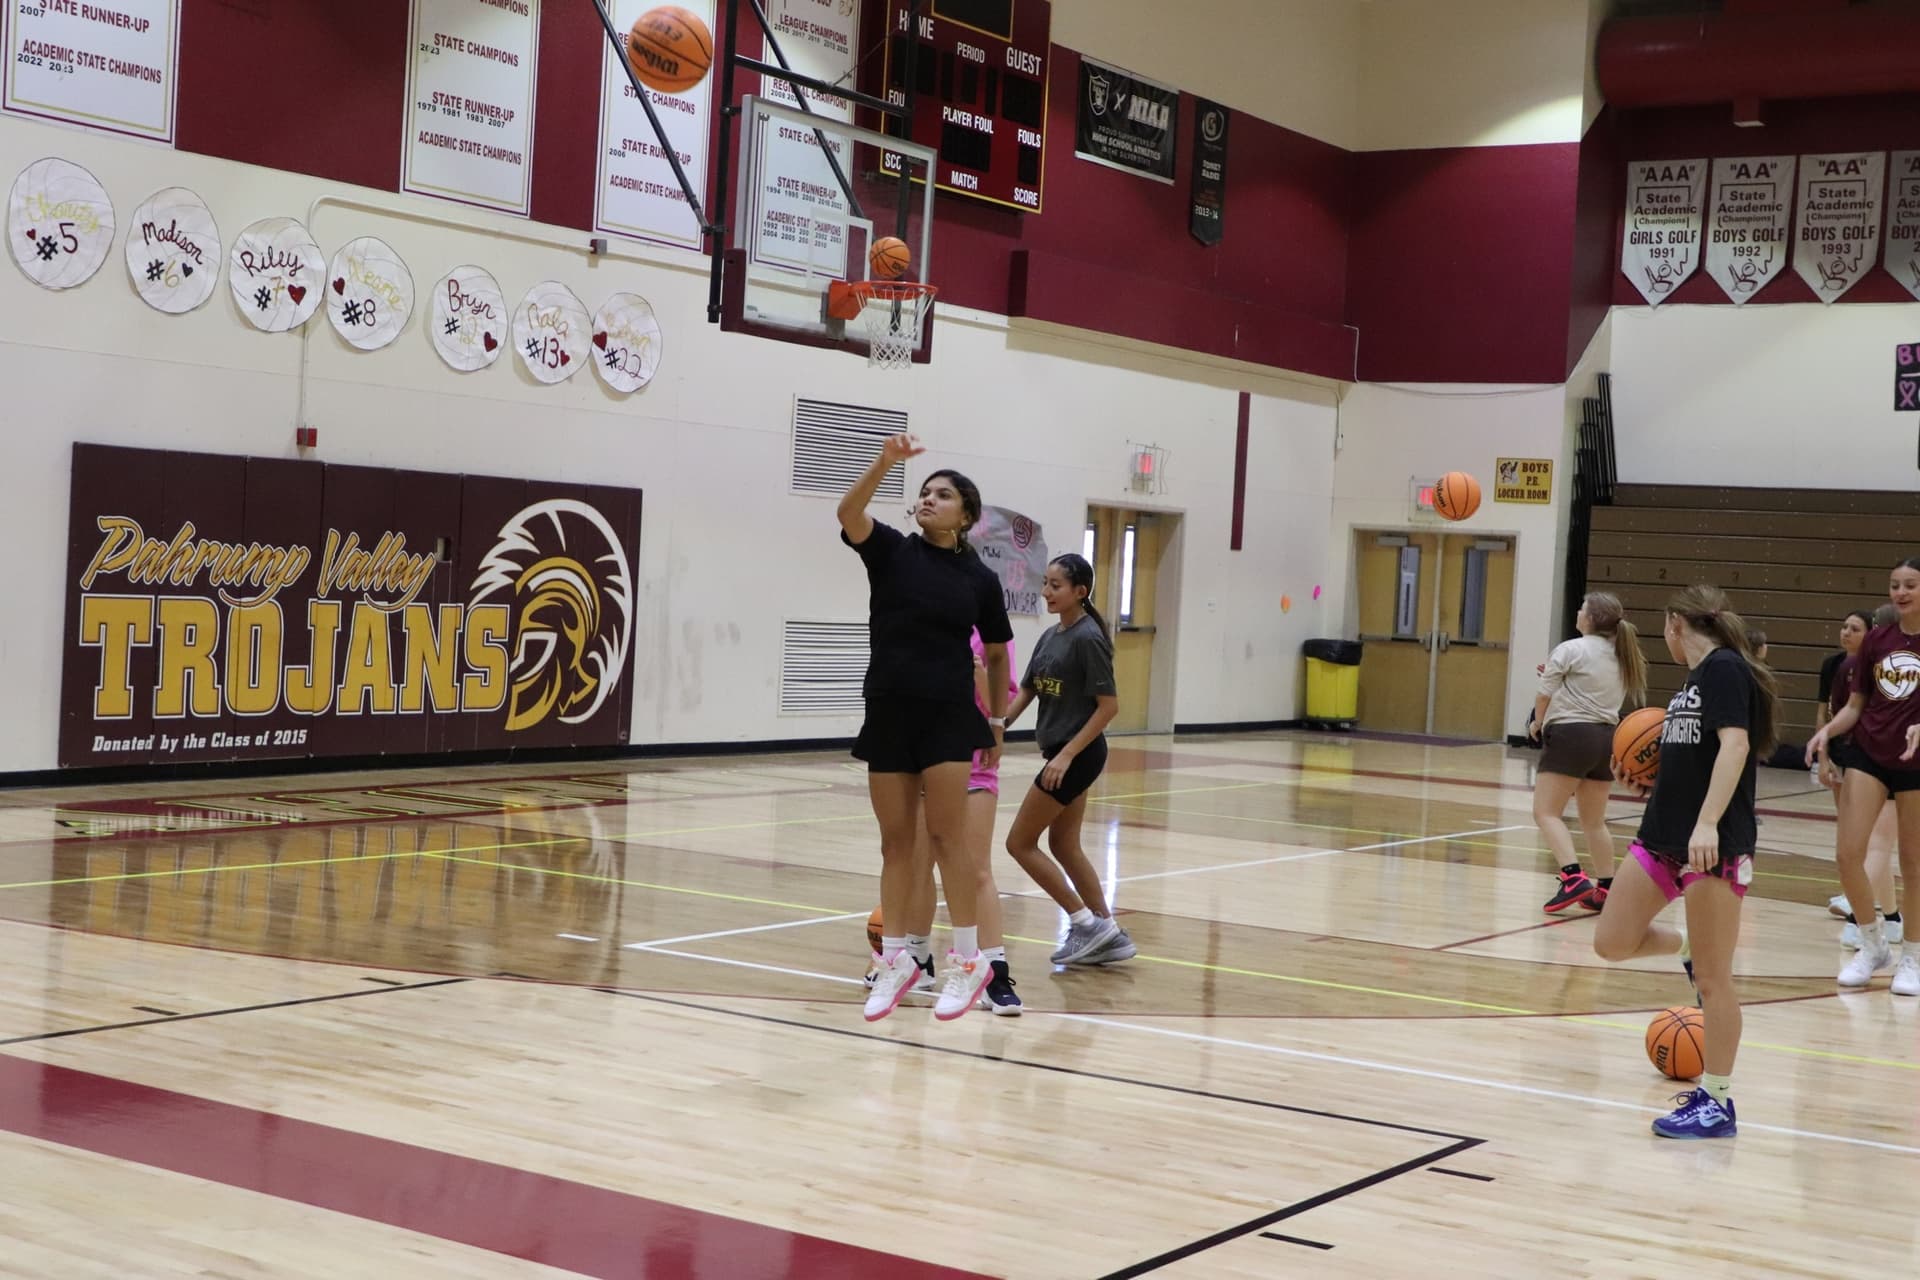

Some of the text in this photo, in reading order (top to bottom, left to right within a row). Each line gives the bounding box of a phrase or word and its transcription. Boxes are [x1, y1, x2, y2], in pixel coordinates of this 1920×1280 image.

[20, 5, 45, 18] 2007
[39, 0, 150, 33] STATE RUNNER-UP
[780, 13, 847, 45] LEAGUE CHAMPIONS
[17, 53, 43, 67] 2022
[434, 33, 519, 67] STATE CHAMPIONS
[957, 42, 985, 64] PERIOD
[23, 38, 162, 84] ACADEMIC STATE CHAMPIONS
[1006, 47, 1042, 76] GUEST
[432, 91, 515, 122] STATE RUNNER-UP
[652, 92, 695, 115] CHAMPIONS
[1127, 94, 1170, 131] NIAA
[417, 102, 505, 128] 1979 1981 1983 2007
[943, 106, 994, 134] PLAYER FOUL
[779, 127, 802, 142] STATE
[1018, 128, 1041, 148] FOULS
[418, 131, 522, 165] ACADEMIC STATE CHAMPIONS
[609, 148, 626, 158] 2006
[622, 138, 647, 155] STATE
[1091, 131, 1161, 160] HIGH SCHOOL ATHLETICS
[610, 174, 643, 192] ACADEMIC
[644, 182, 663, 197] STATE
[777, 176, 837, 200] STATE RUNNER-UP
[951, 170, 978, 191] MATCH
[1014, 187, 1038, 206] SCORE
[1646, 192, 1681, 204] State
[1730, 190, 1766, 201] State
[1818, 187, 1856, 199] State
[1634, 204, 1697, 216] Academic
[1717, 202, 1783, 213] Academic
[1806, 199, 1874, 211] Academic
[767, 209, 796, 226] ACADEMIC
[797, 217, 810, 229] STAT
[1639, 216, 1686, 225] Champions
[1722, 214, 1772, 224] Champions
[1811, 212, 1862, 221] Champions
[36, 222, 79, 261] #5
[142, 219, 204, 265] Madison
[1630, 230, 1697, 245] GIRLS GOLF
[1713, 227, 1785, 243] BOYS GOLF
[1802, 225, 1876, 241] BOYS GOLF
[1649, 248, 1674, 259] 1991
[1733, 246, 1761, 257] 1992
[1822, 243, 1851, 255] 1993
[240, 246, 304, 277] Riley
[146, 257, 182, 288] #6
[253, 276, 287, 311] #7
[447, 278, 496, 320] Bryn
[341, 298, 376, 327] #8
[526, 336, 560, 369] #13
[604, 347, 645, 380] #22
[1522, 462, 1549, 474] BOYS
[1497, 488, 1548, 500] LOCKER ROOM
[80, 515, 437, 613] Pahrump Valley
[1606, 565, 1612, 577] 1
[1659, 568, 1668, 580] 2
[79, 592, 510, 720] TROJANS
[92, 729, 307, 753] Donated by the Class of 2015
